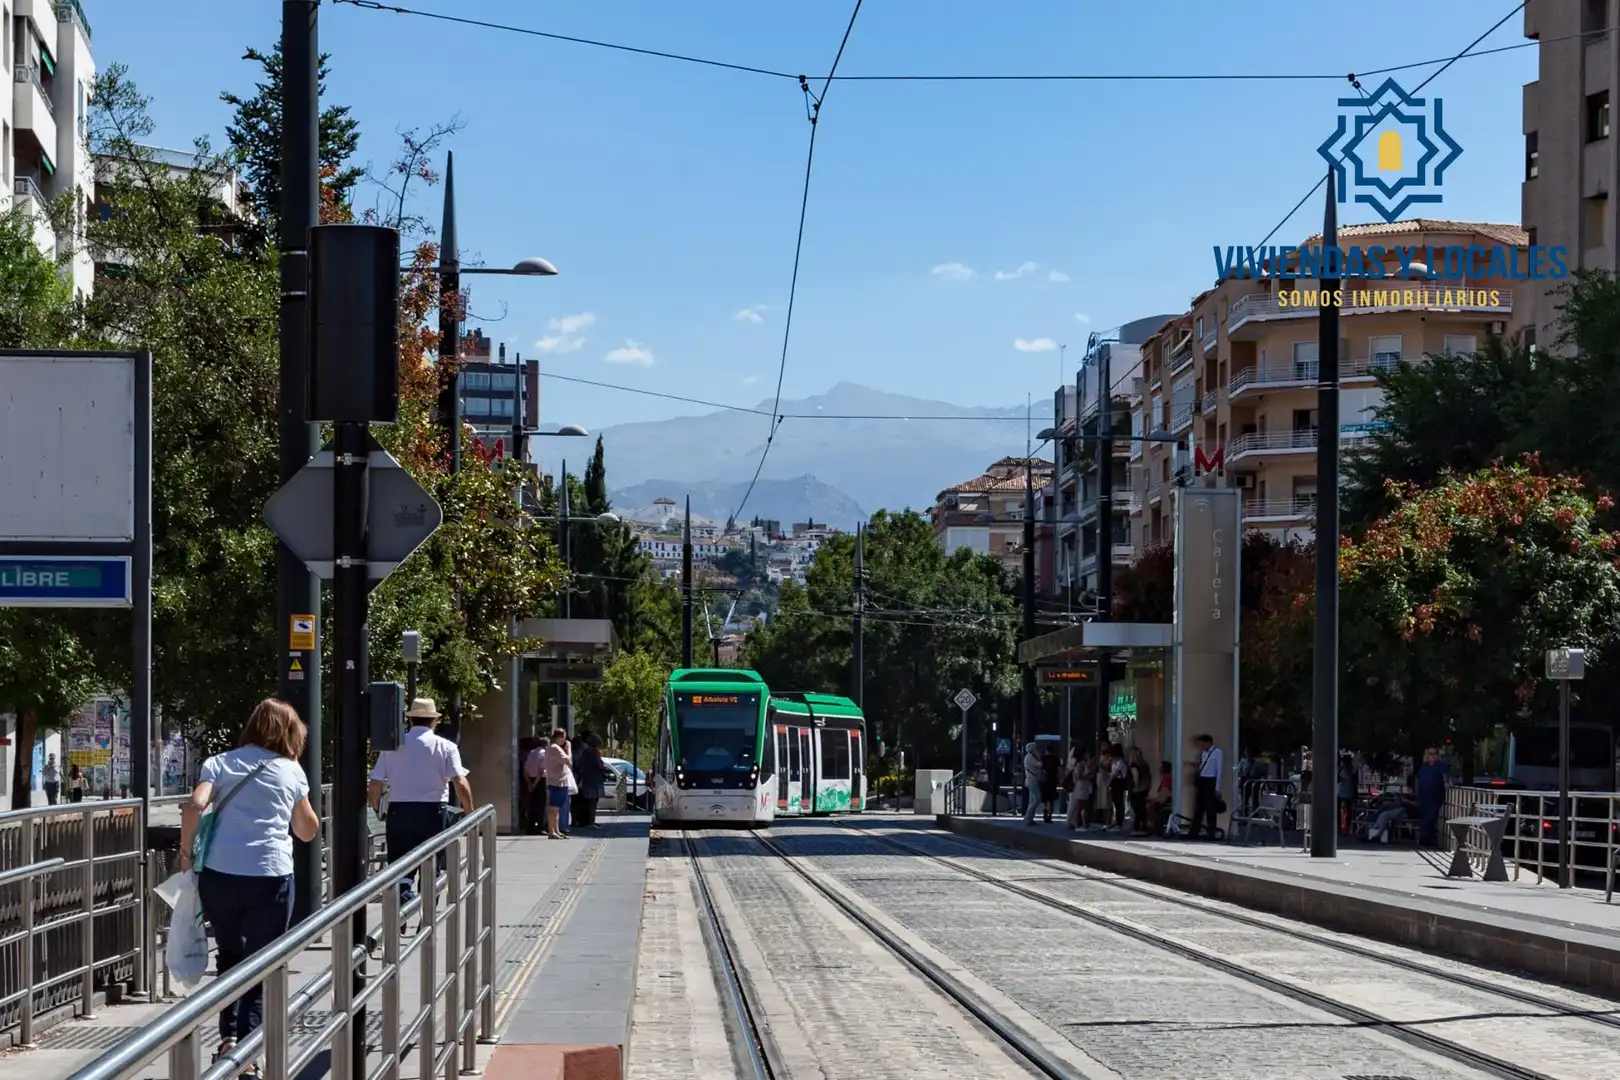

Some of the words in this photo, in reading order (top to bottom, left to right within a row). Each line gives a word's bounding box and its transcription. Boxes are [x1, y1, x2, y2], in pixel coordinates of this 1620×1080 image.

[1194, 446, 1224, 473] M
[1, 571, 70, 588] LIBRE
[1212, 528, 1223, 620] Caleta
